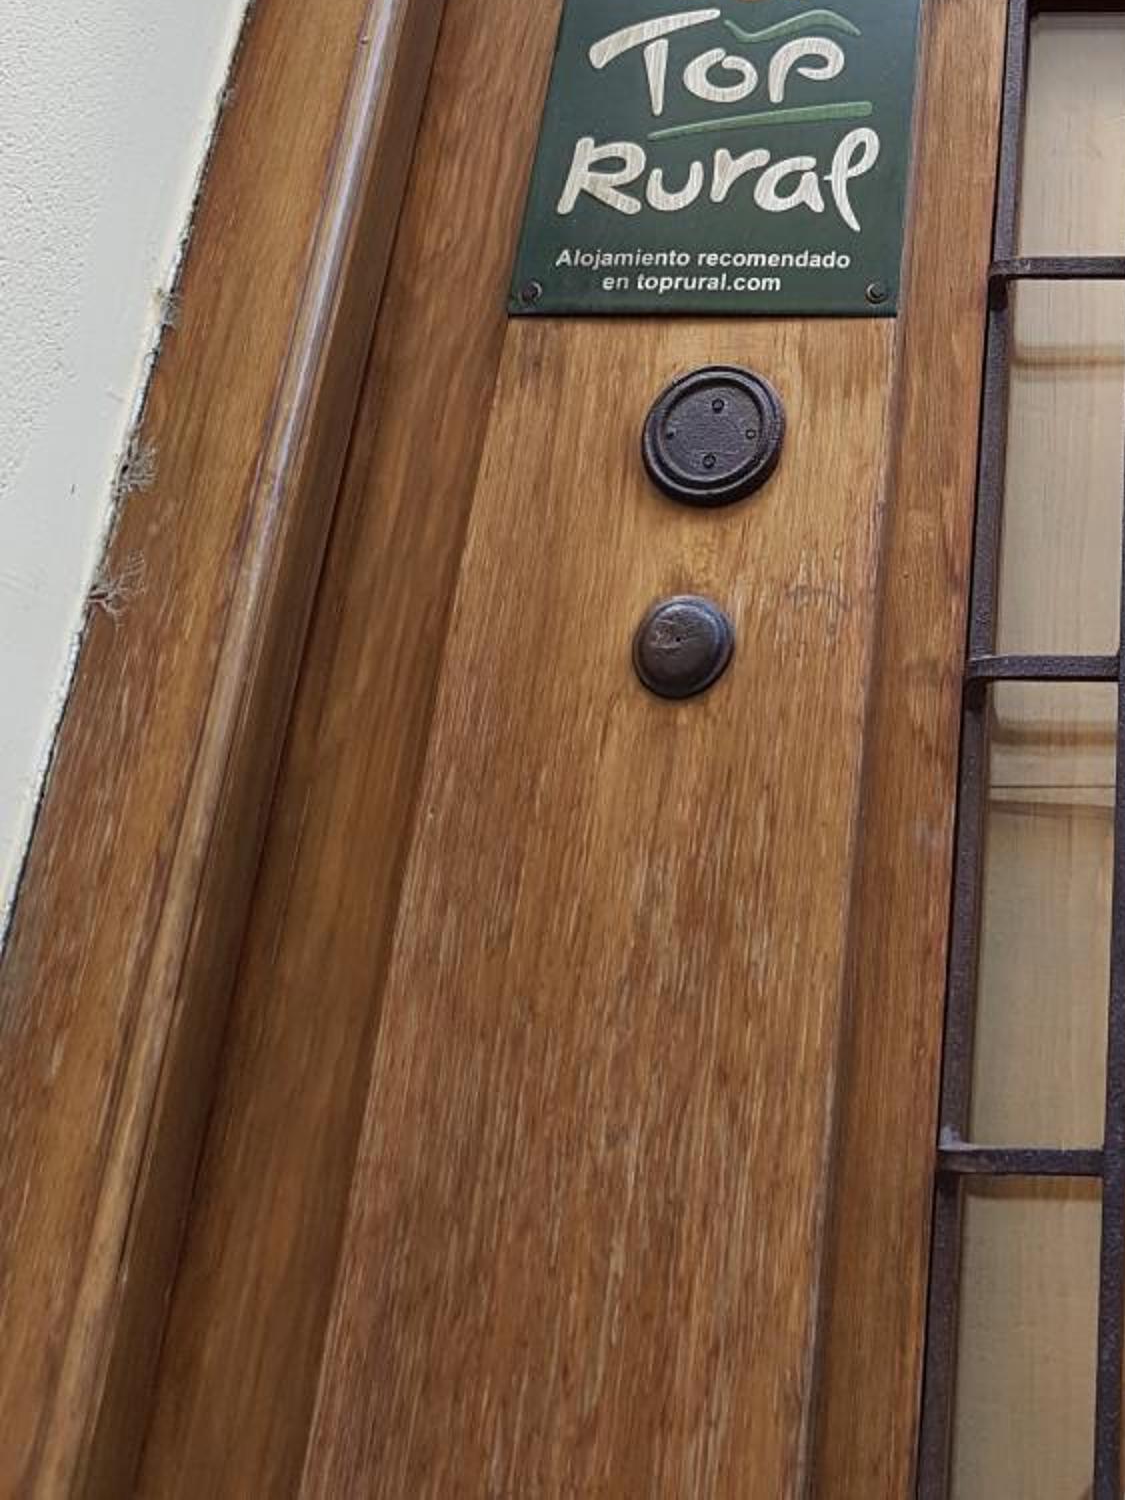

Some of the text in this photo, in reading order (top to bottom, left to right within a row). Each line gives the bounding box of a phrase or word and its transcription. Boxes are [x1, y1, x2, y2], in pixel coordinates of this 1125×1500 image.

[555, 126, 882, 233] Rural
[555, 248, 851, 270] Alojamiento recomendado
[602, 273, 782, 294] en toprural.com
